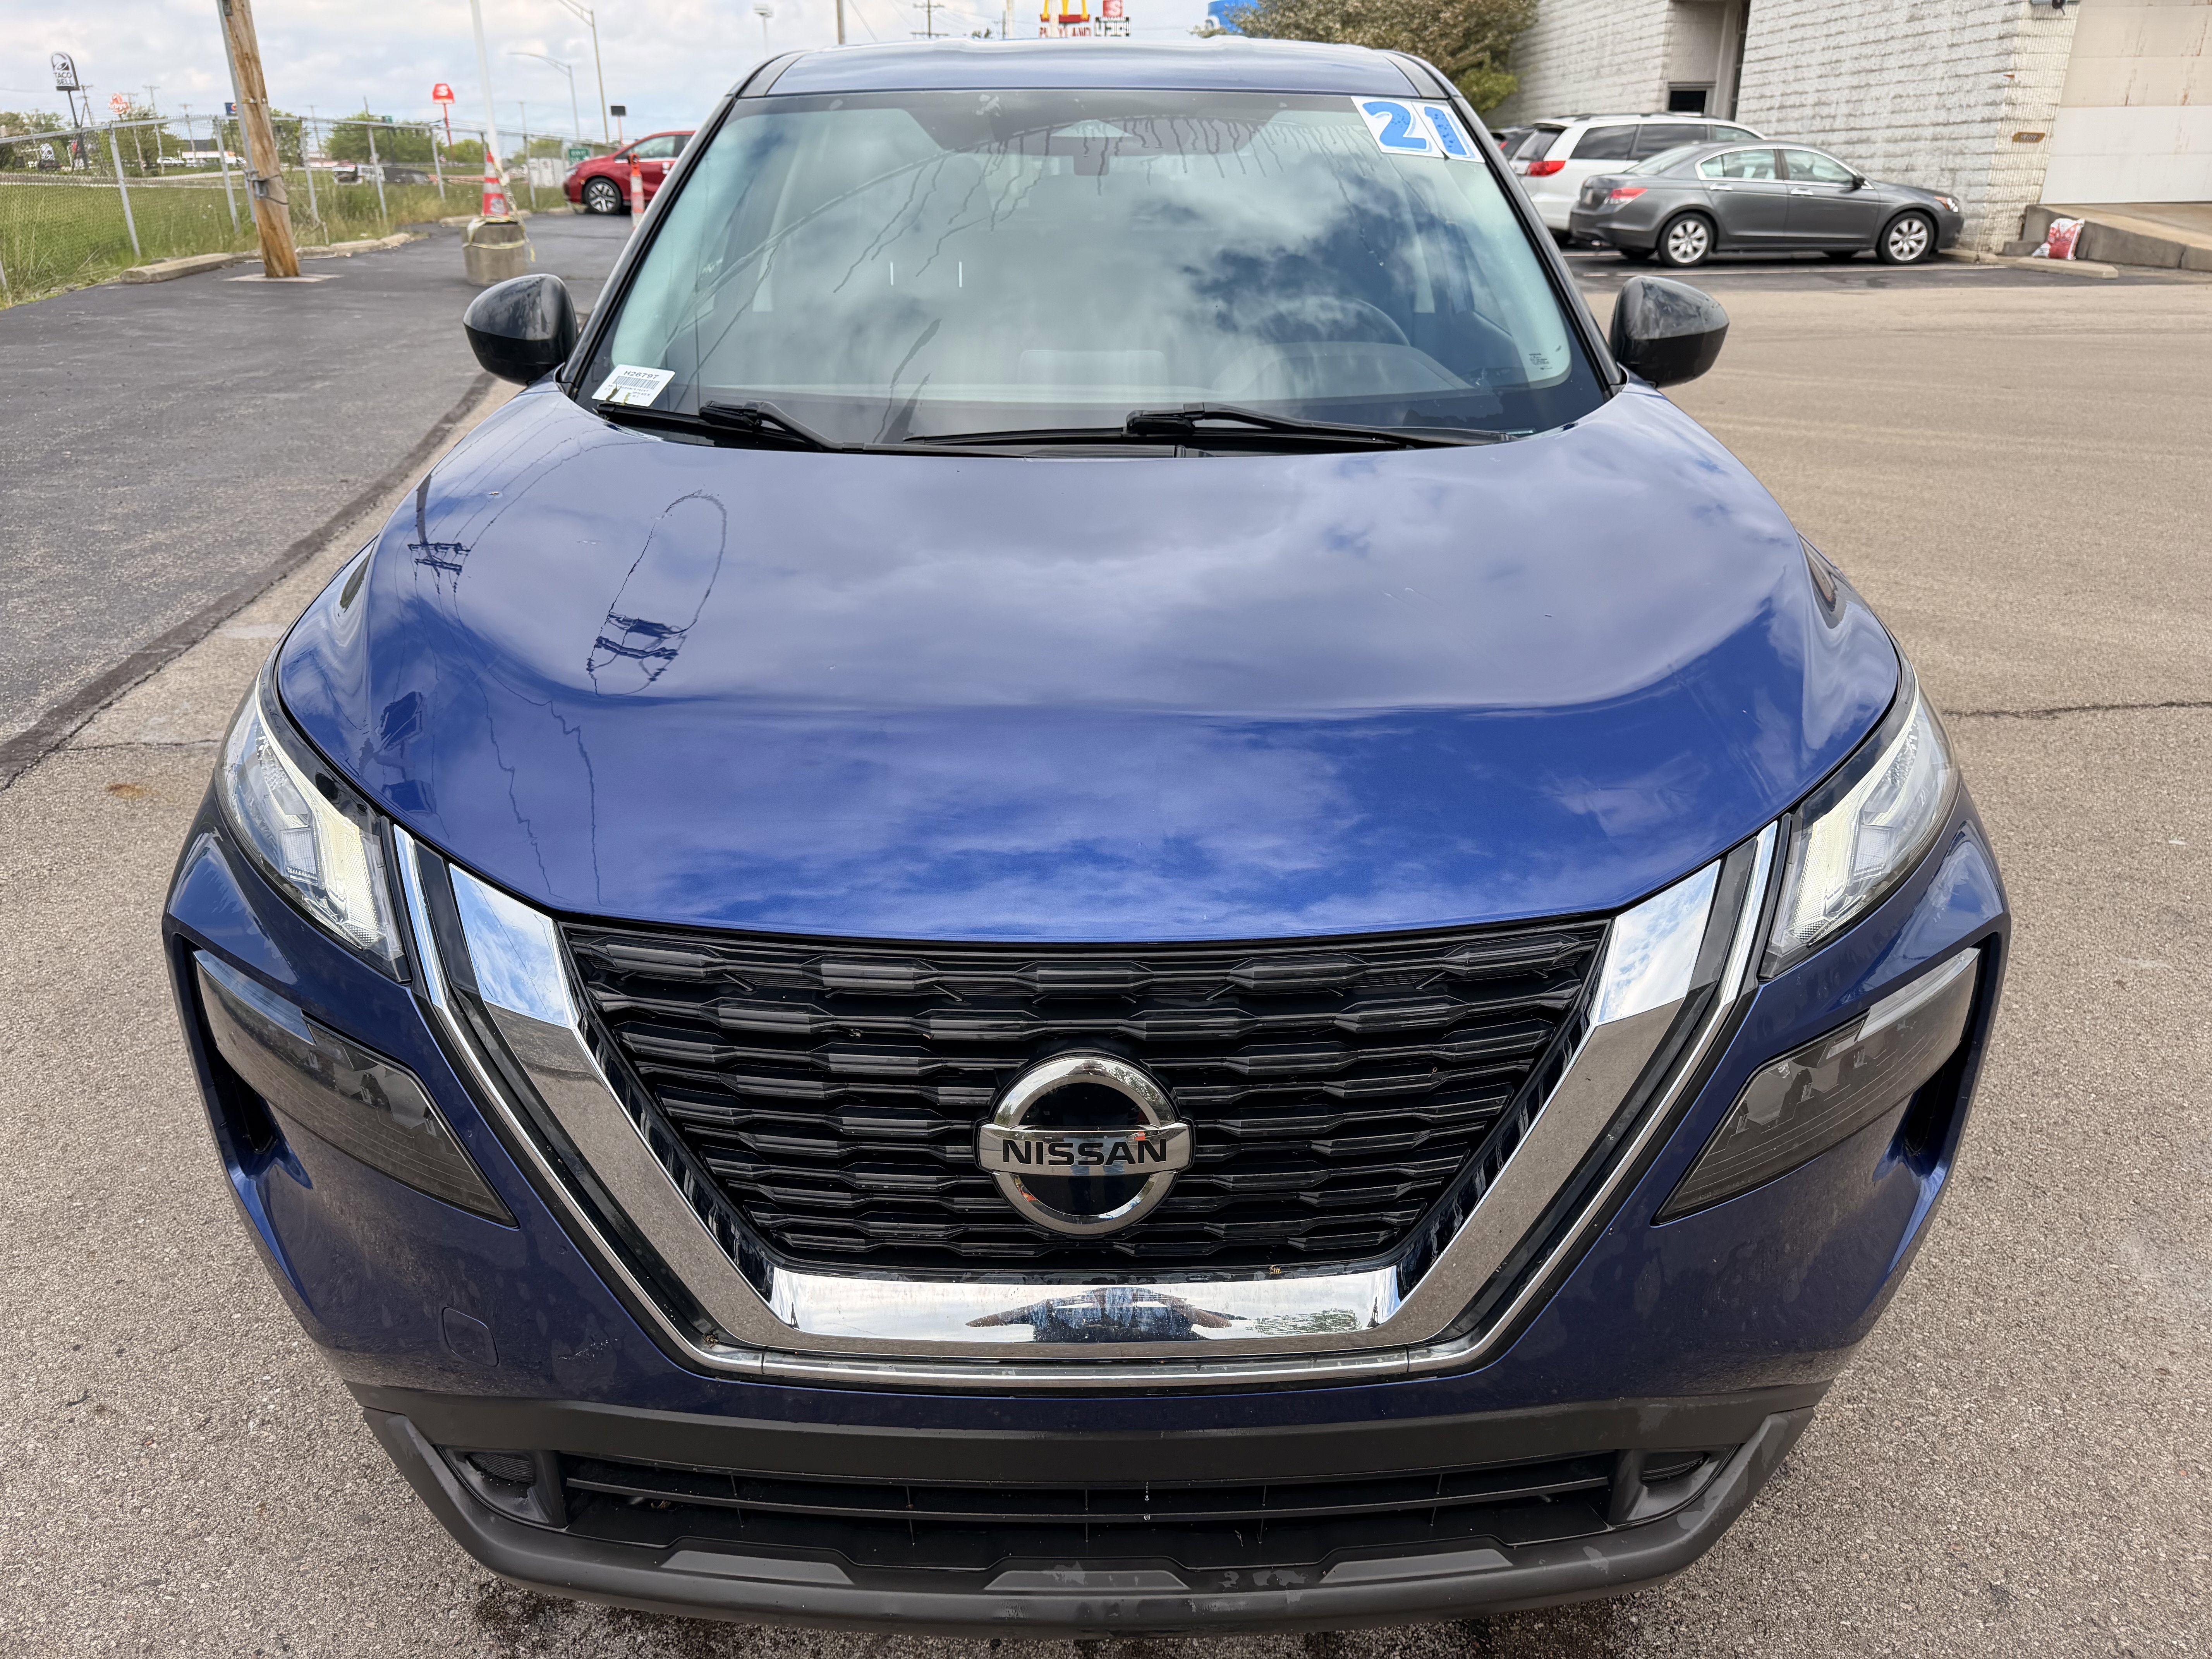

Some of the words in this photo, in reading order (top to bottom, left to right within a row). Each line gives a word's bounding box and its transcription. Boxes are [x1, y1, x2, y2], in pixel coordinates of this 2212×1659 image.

[1362, 101, 1468, 156] 21
[623, 371, 659, 380] H26797
[1003, 1139, 1166, 1166] NISSAN
